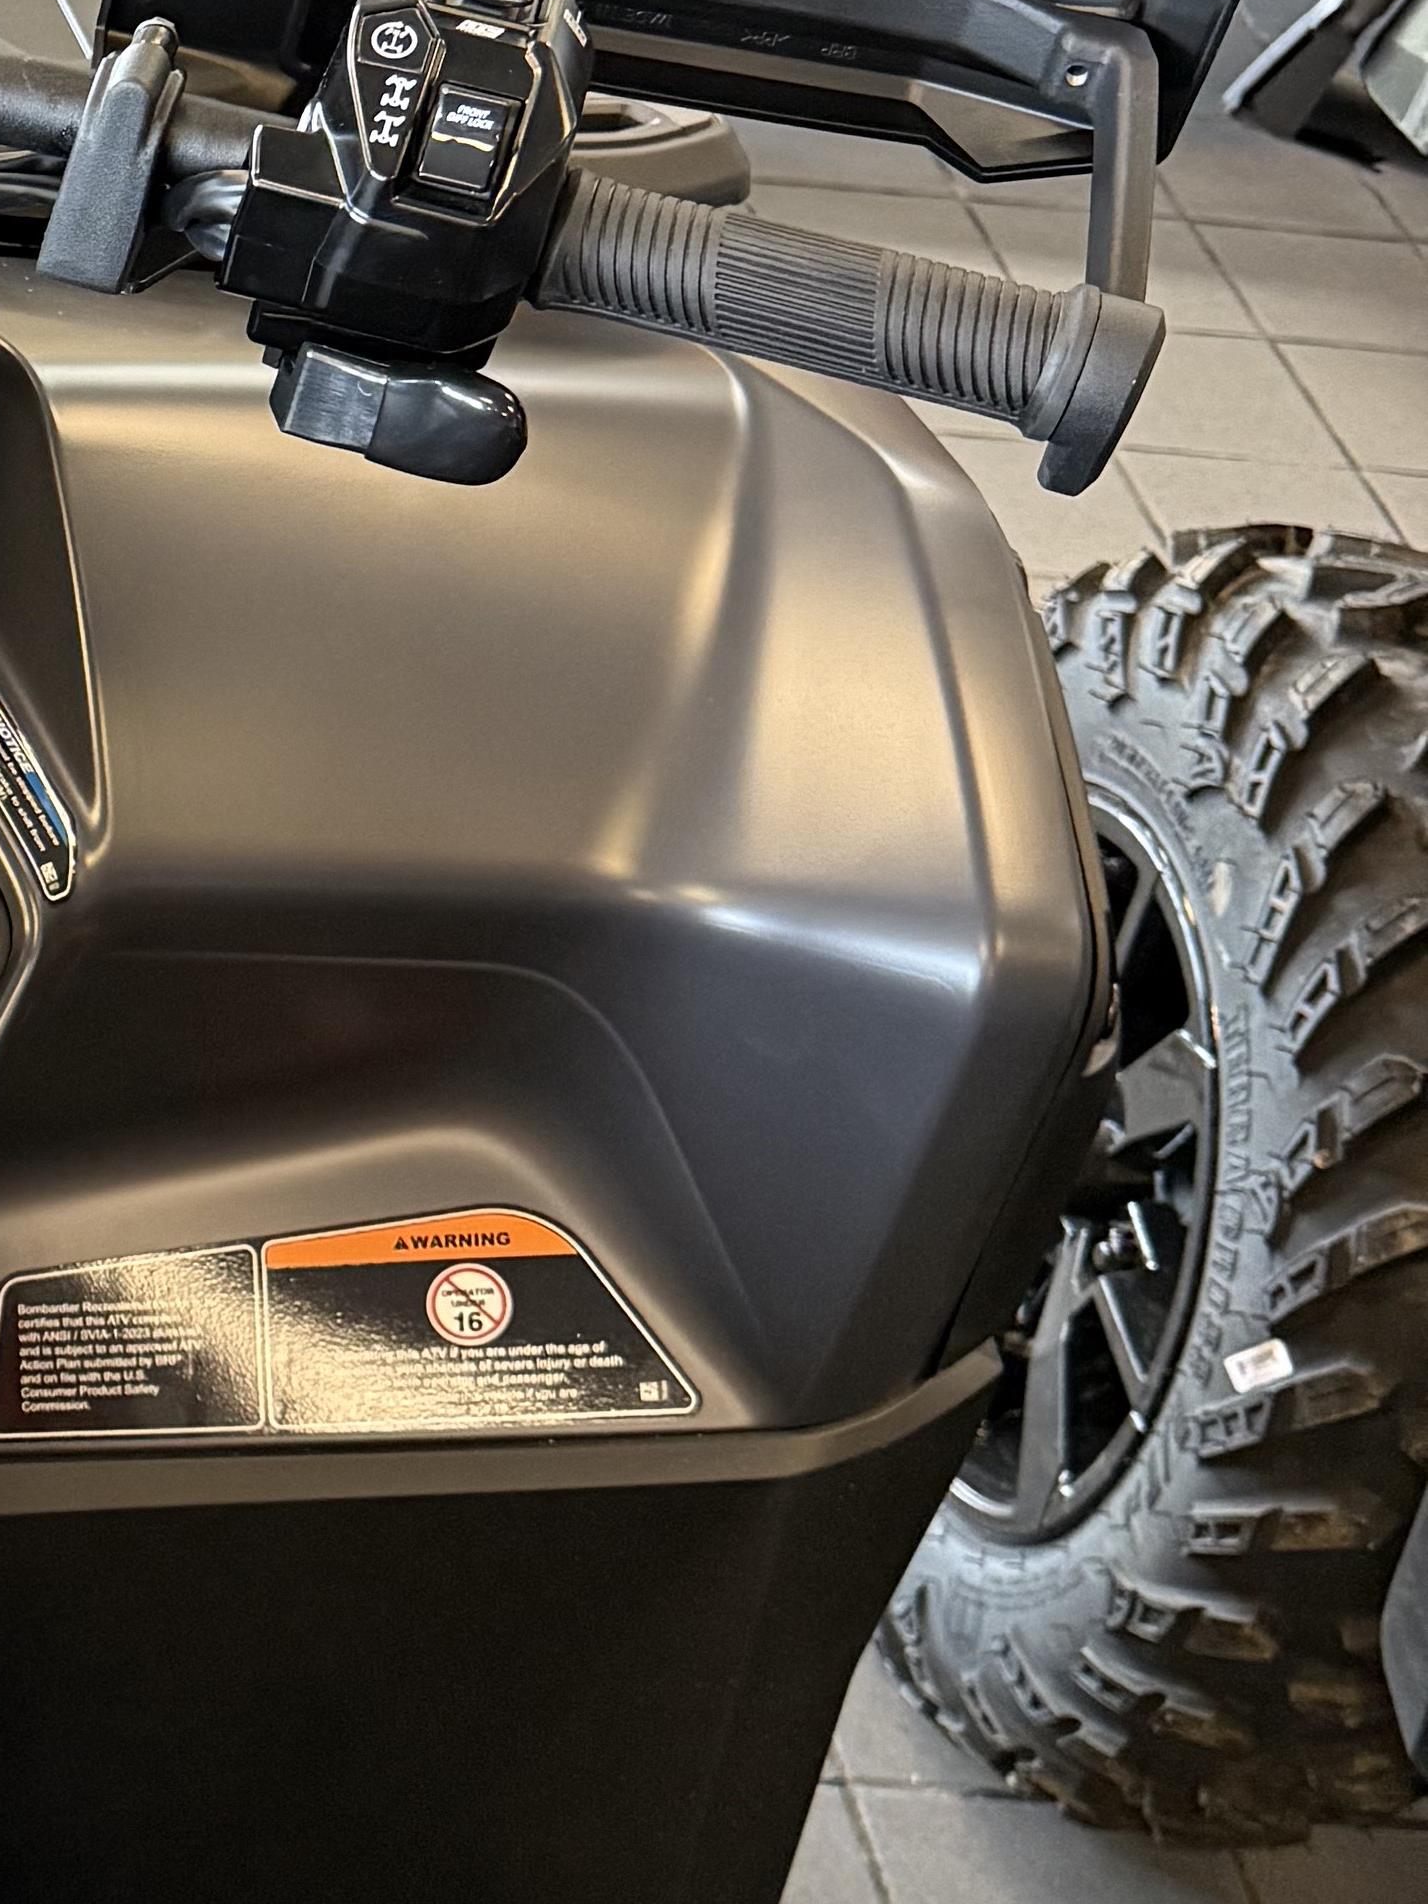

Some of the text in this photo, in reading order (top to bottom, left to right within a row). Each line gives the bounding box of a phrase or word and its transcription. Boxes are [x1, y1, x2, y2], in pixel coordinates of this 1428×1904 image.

[410, 1231, 512, 1250] WARNING
[17, 1303, 79, 1314] Bombardier
[453, 1310, 484, 1332] 16
[19, 1360, 53, 1369] Action
[55, 1358, 81, 1368] Plan
[83, 1356, 136, 1367] submitted
[20, 1373, 41, 1384] and
[59, 1372, 76, 1382] file
[78, 1371, 101, 1381] with
[102, 1371, 121, 1381] the
[123, 1369, 147, 1381] U.S.
[21, 1383, 159, 1397] Consumer Product Safety
[21, 1401, 89, 1411] Commission.
